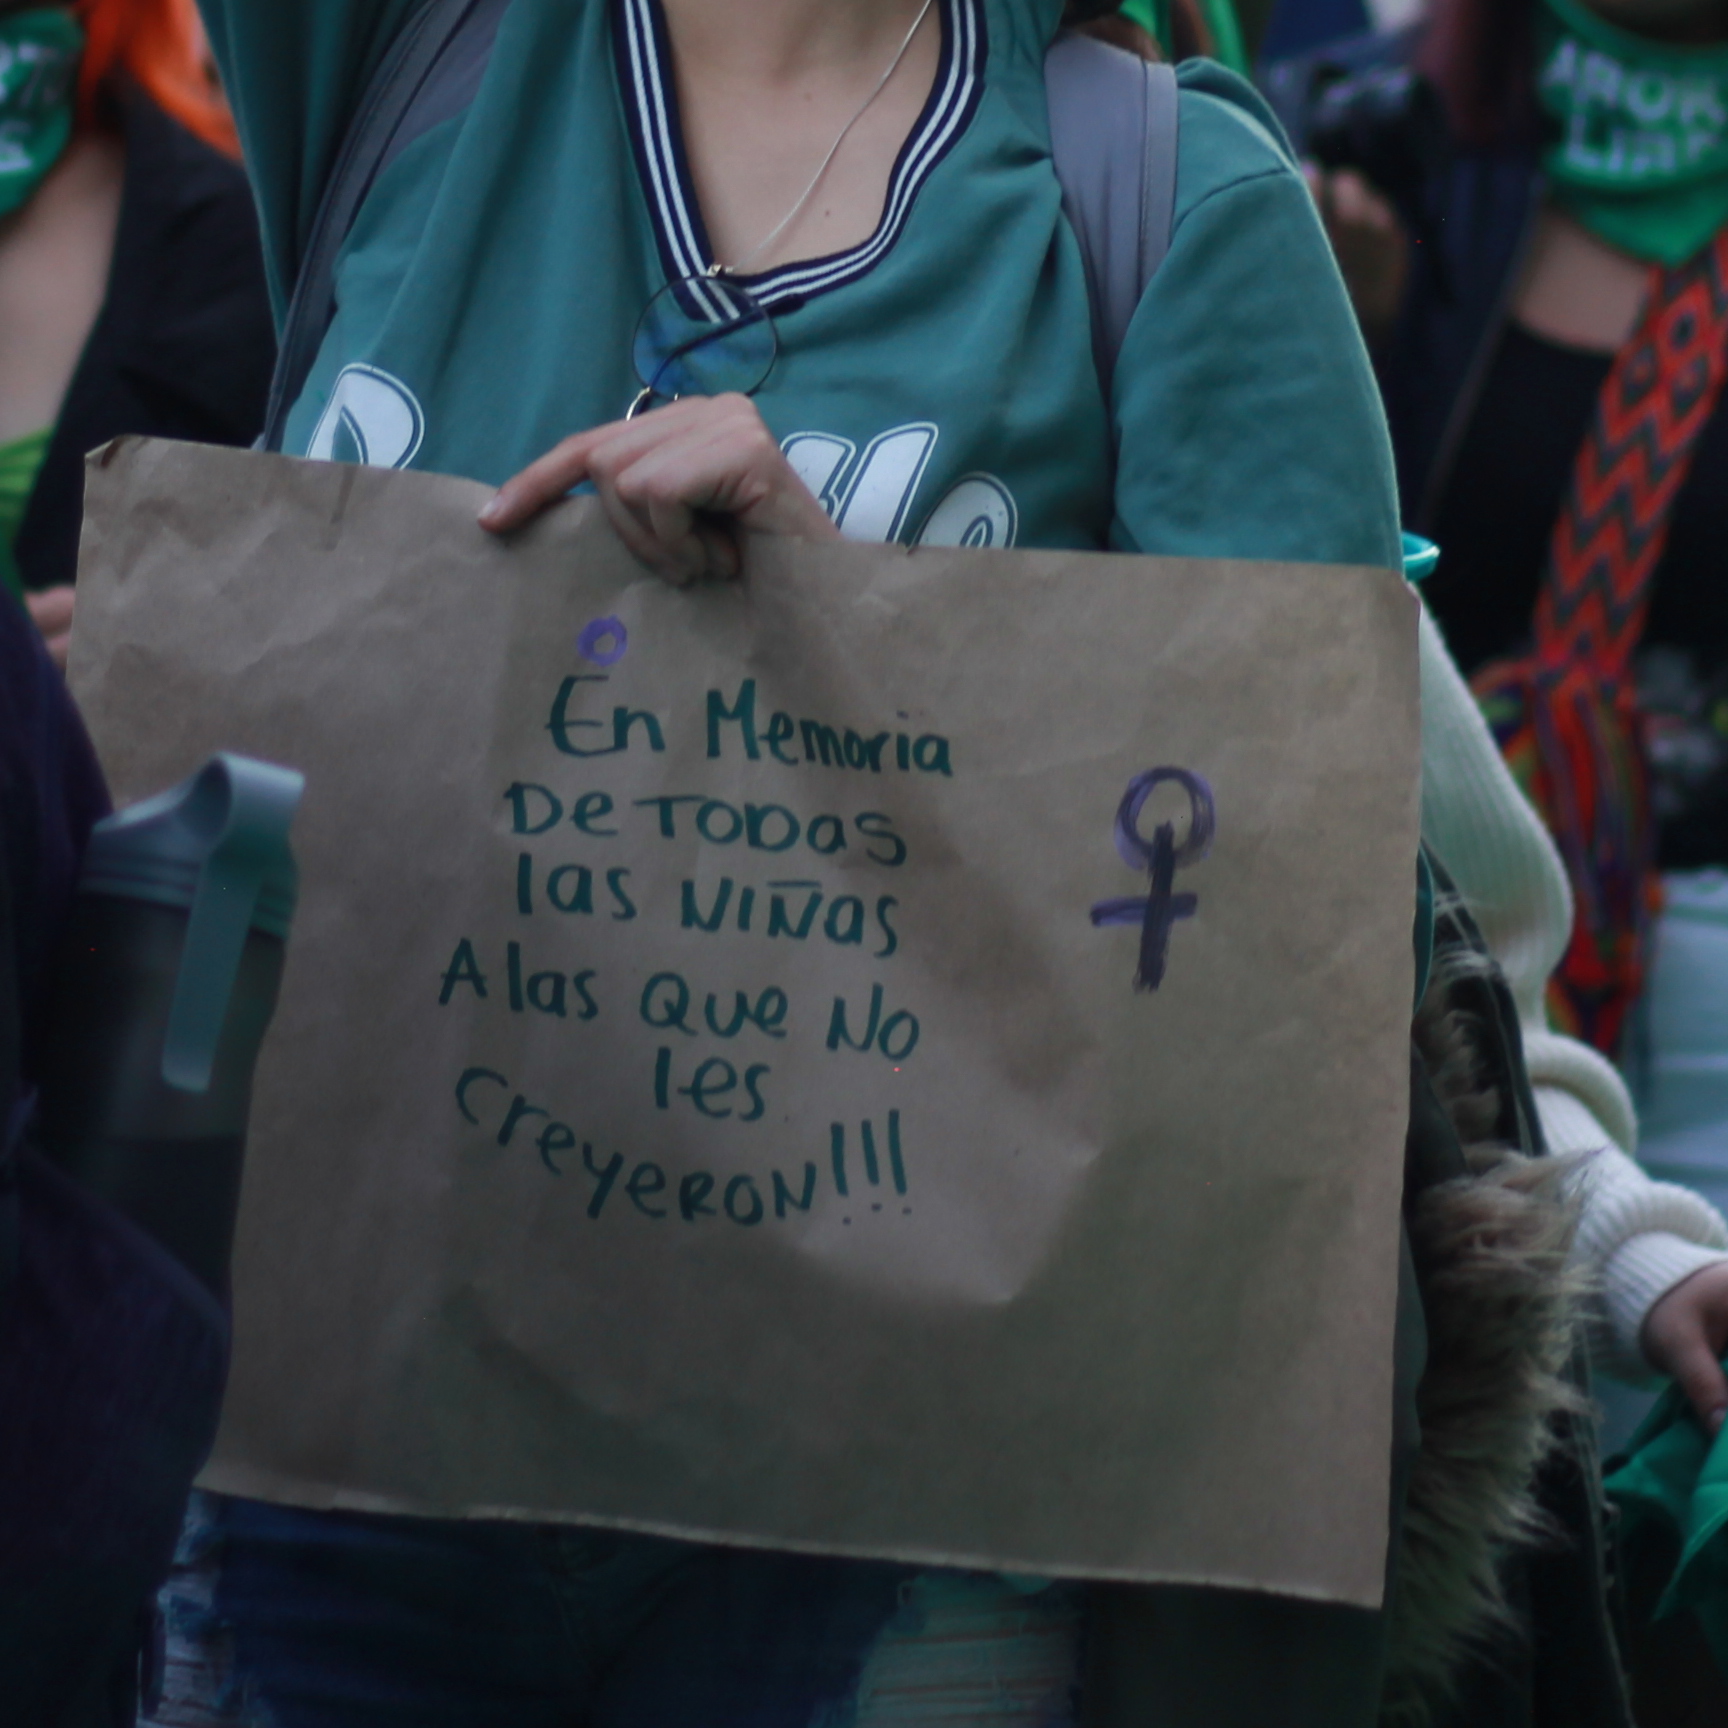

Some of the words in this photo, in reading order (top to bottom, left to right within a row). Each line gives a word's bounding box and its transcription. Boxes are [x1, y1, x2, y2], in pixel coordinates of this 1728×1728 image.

[544, 674, 666, 758] En
[705, 677, 954, 778] Memoria
[516, 852, 638, 922] las
[638, 970, 791, 1039] Que
[653, 1045, 772, 1122] les
